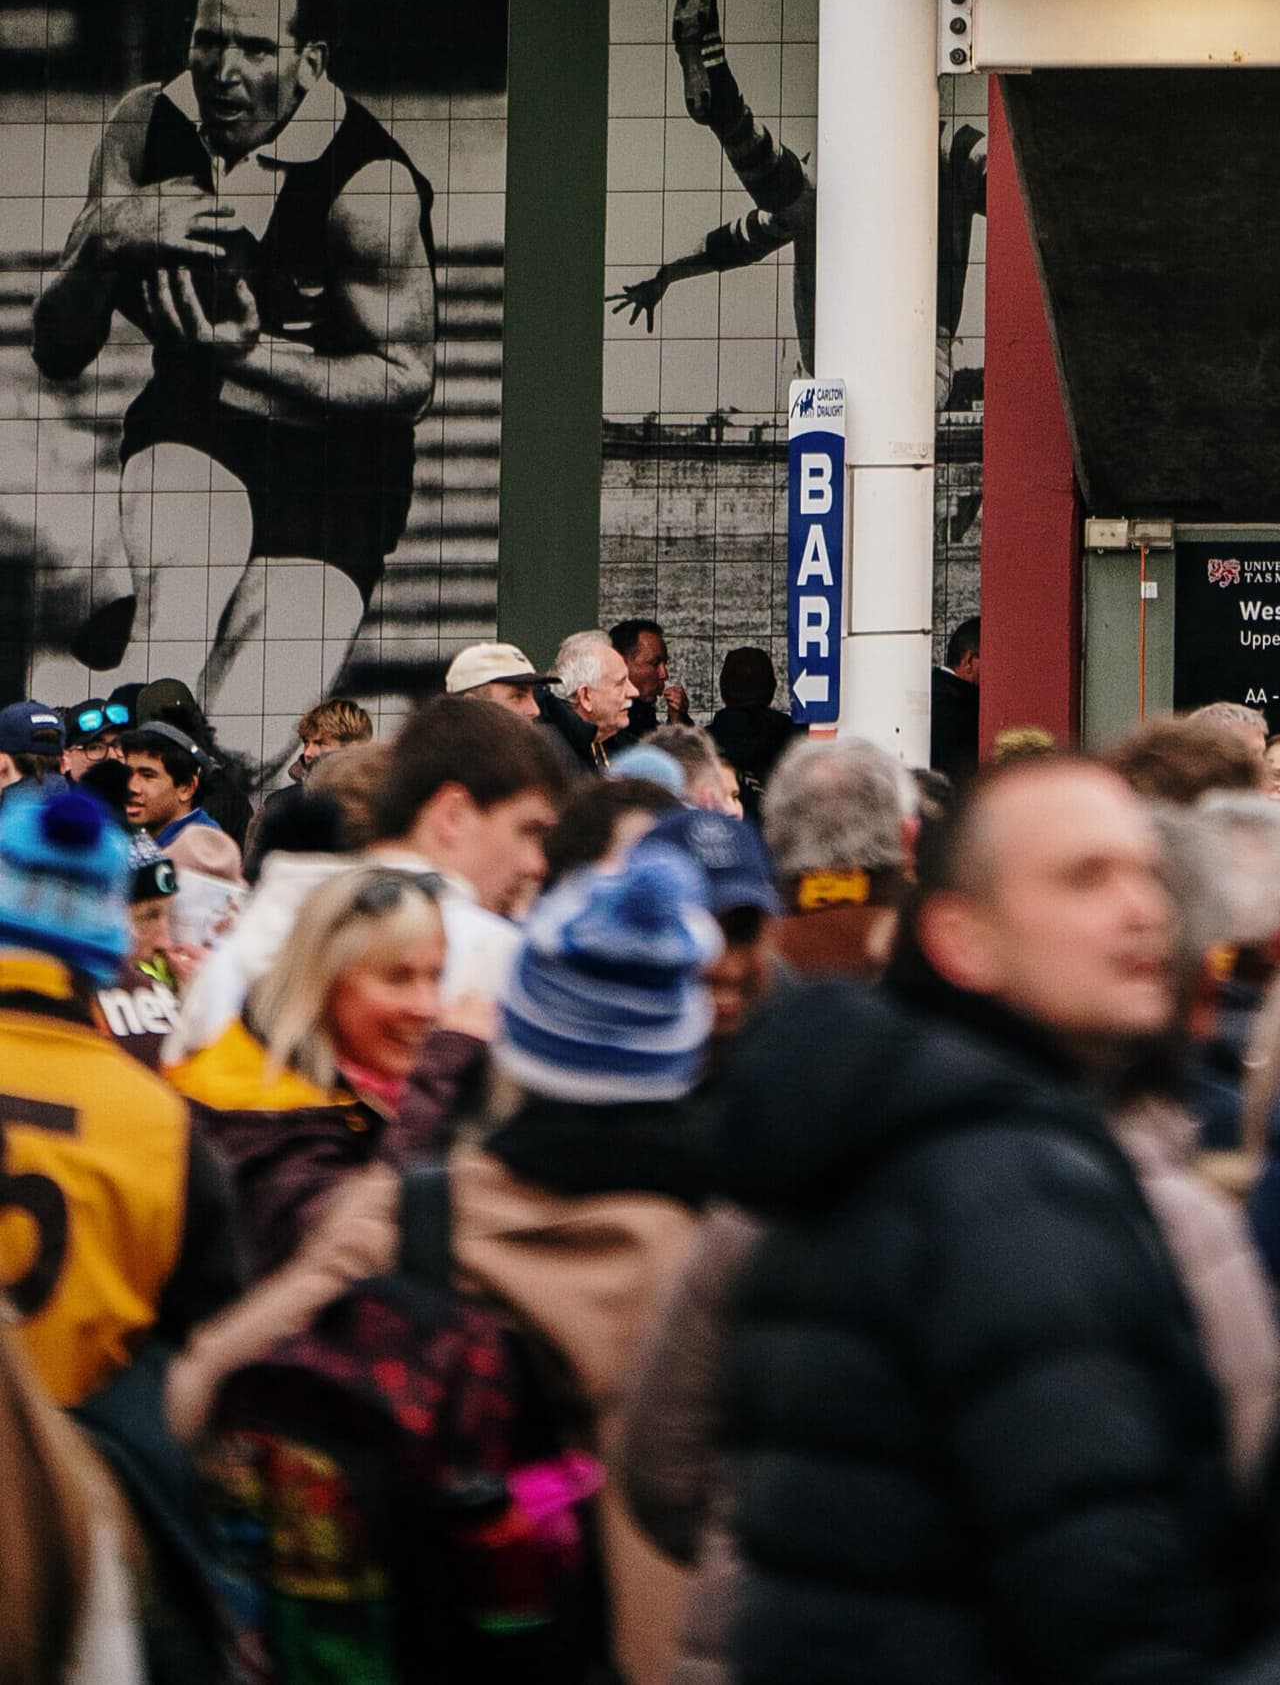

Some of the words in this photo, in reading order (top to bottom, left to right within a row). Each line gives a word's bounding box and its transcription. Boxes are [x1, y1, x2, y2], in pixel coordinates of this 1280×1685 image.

[816, 387, 844, 401] CARLTON
[816, 405, 844, 418] DRAUGHT
[796, 452, 834, 658] BAR
[1244, 688, 1268, 704] AA
